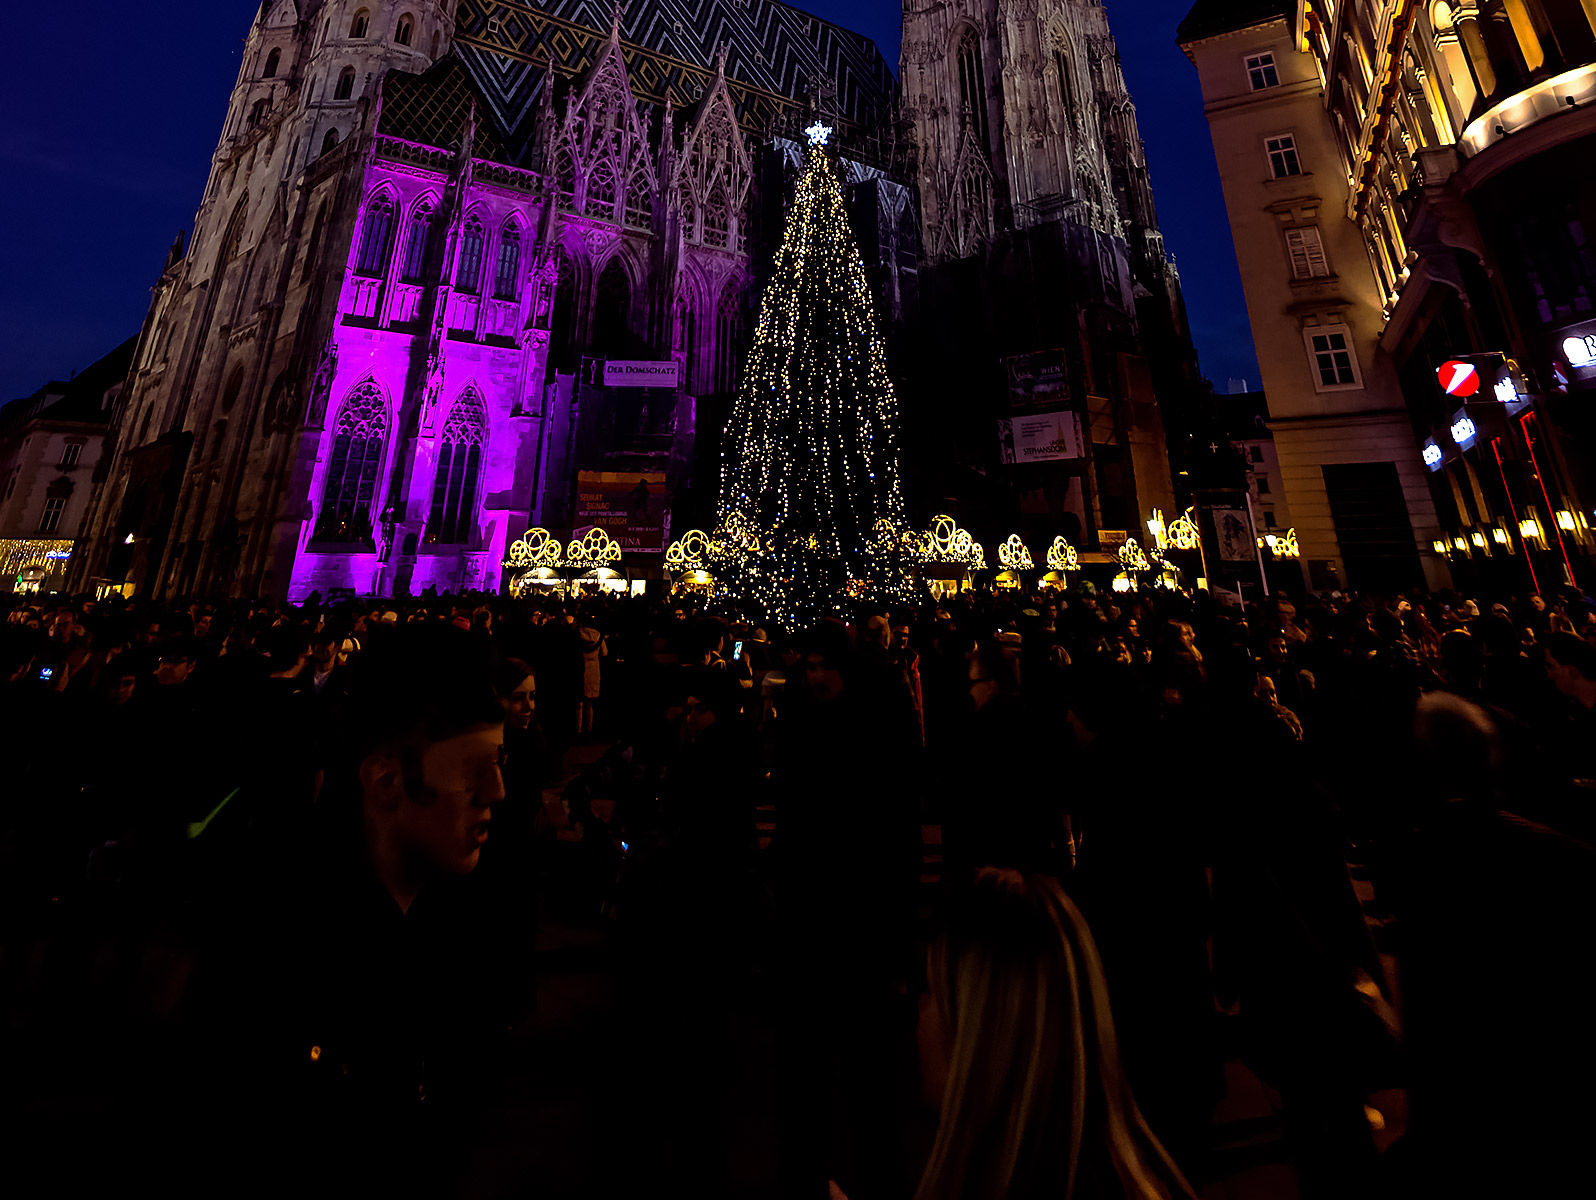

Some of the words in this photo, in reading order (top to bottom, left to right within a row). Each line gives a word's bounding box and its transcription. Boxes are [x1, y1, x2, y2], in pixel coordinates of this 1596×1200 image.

[607, 365, 624, 374] DER
[625, 365, 676, 375] DOMSCHATZ
[579, 493, 604, 502] SEURAT
[585, 502, 610, 510] SIGNAC
[593, 517, 607, 525] VAN
[608, 516, 628, 525] GOGH
